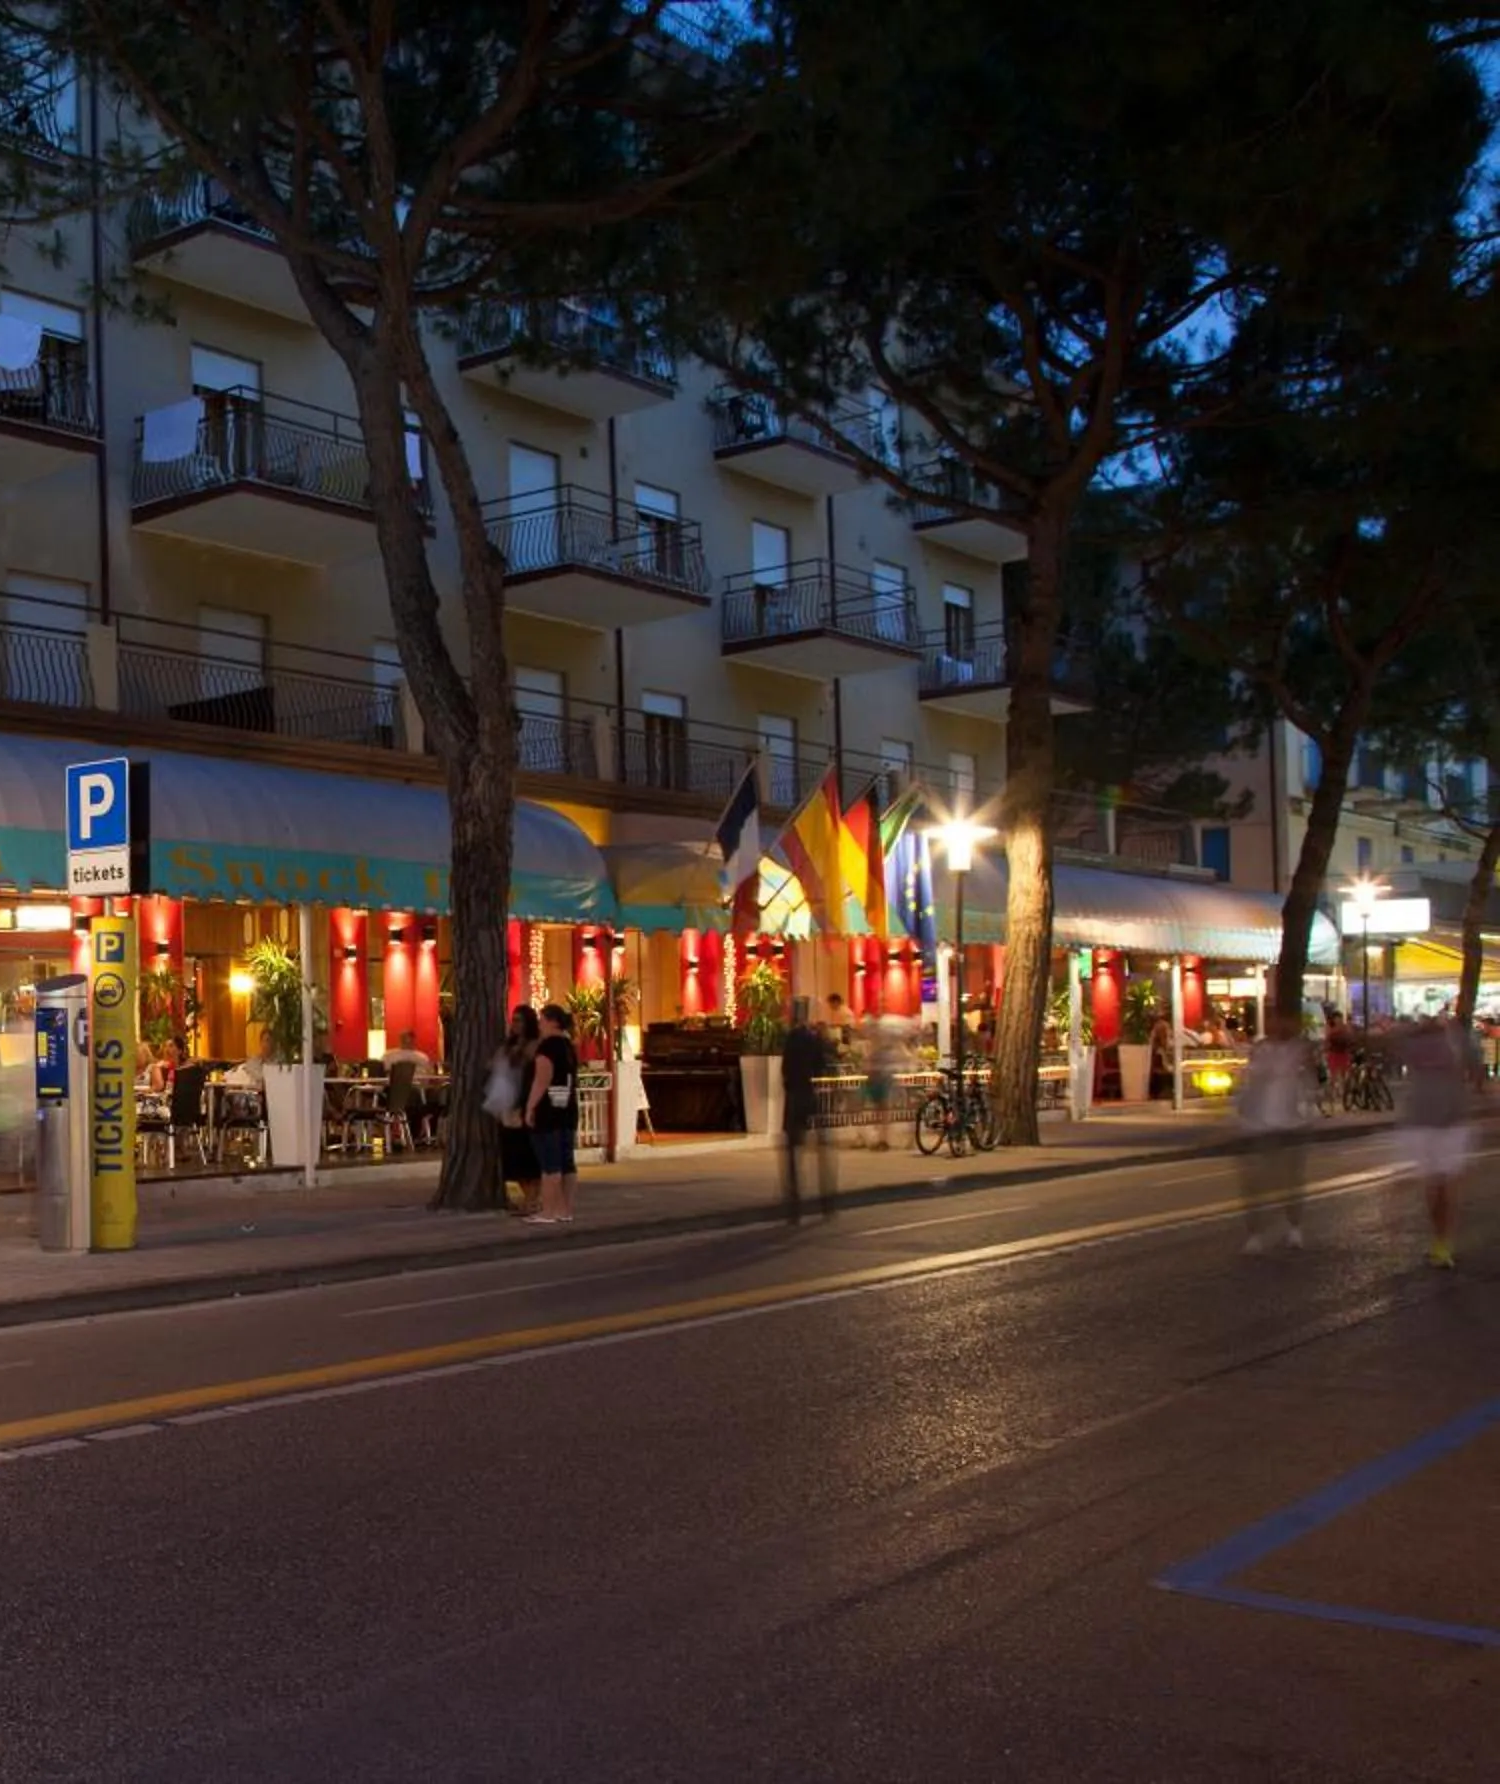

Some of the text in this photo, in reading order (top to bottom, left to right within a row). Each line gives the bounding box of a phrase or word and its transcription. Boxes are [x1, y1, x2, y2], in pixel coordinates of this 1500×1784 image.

[79, 773, 115, 840] P
[73, 863, 125, 884] tickets
[167, 844, 390, 898] Snack
[100, 933, 121, 961] P
[95, 1037, 124, 1177] TICKETS
